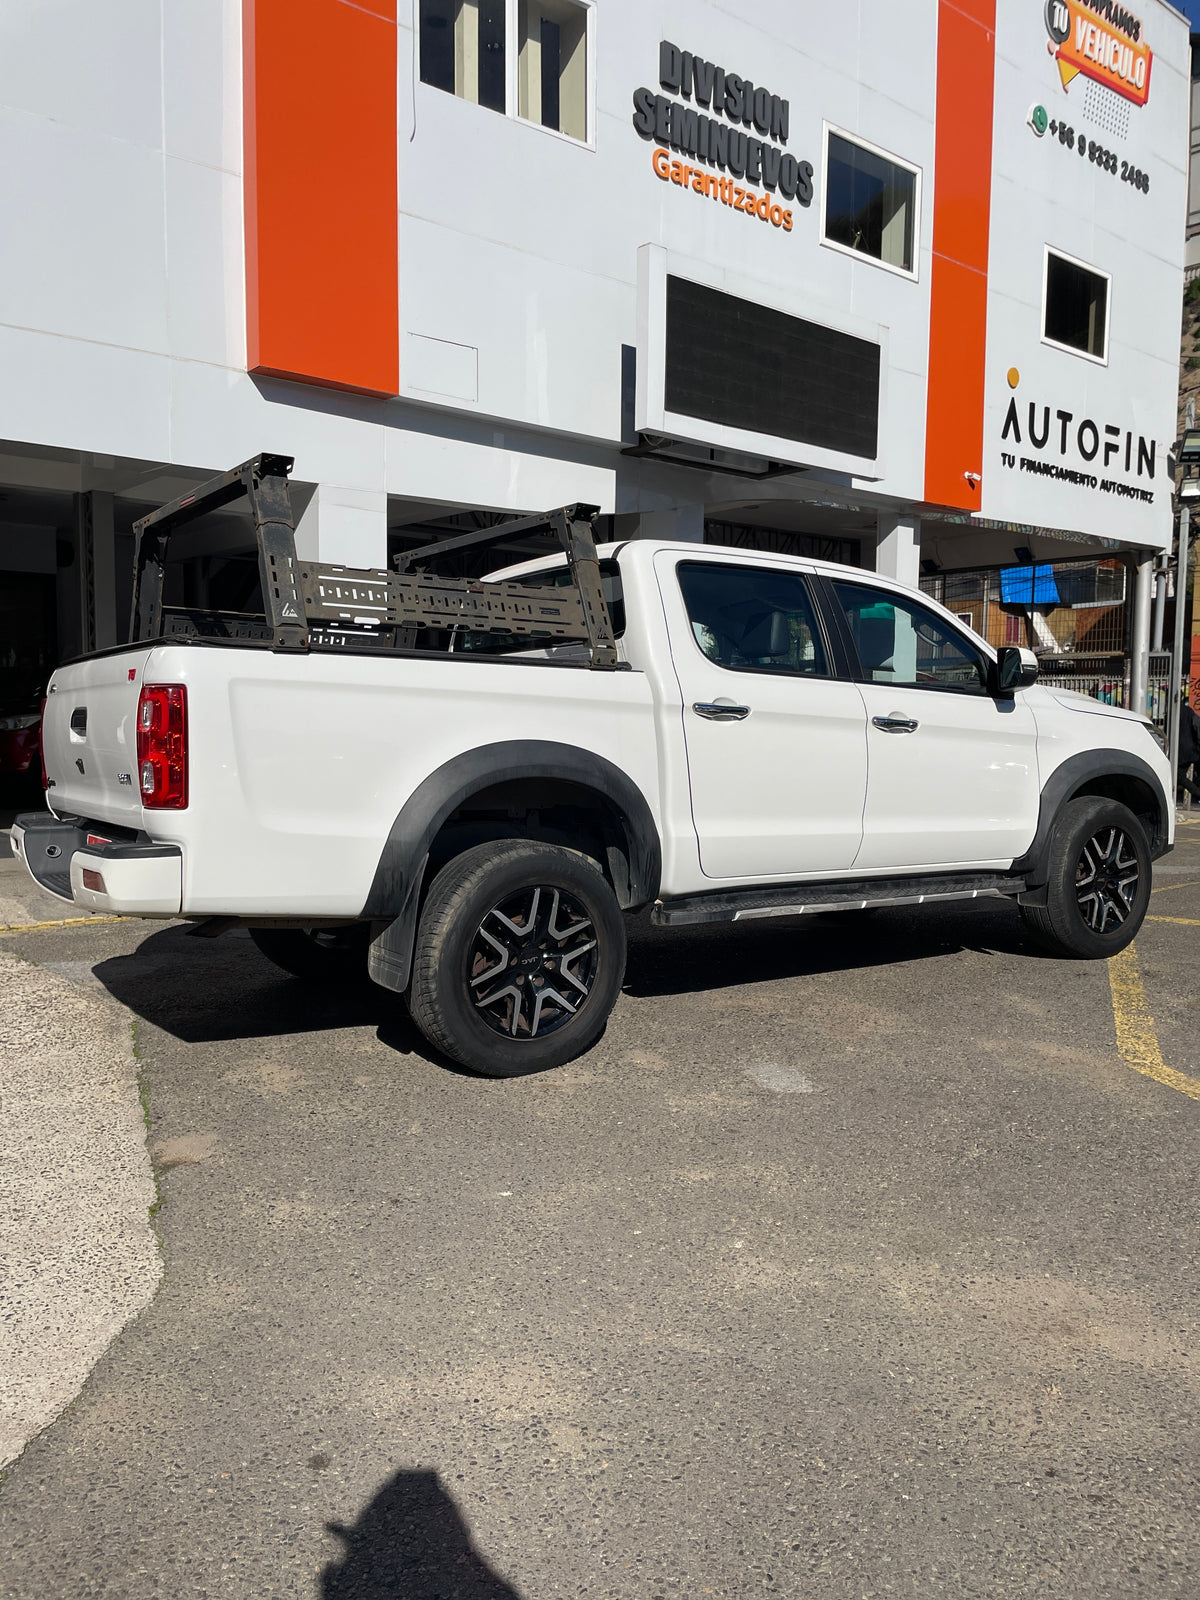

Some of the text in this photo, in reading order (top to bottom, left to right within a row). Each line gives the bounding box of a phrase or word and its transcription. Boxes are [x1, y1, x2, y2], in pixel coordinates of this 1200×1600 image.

[1052, 1, 1146, 89] TU VEHICULO
[659, 40, 789, 146] DIVISION
[633, 87, 814, 208] SEMINUEVOS
[1049, 119, 1075, 150] +56
[1077, 134, 1087, 157] 9
[652, 148, 793, 232] Garantizados
[1001, 397, 1156, 479] AUTOFIN
[1001, 452, 1155, 504] TU FINANCIAMIENTO AUTOMOTRIZ
